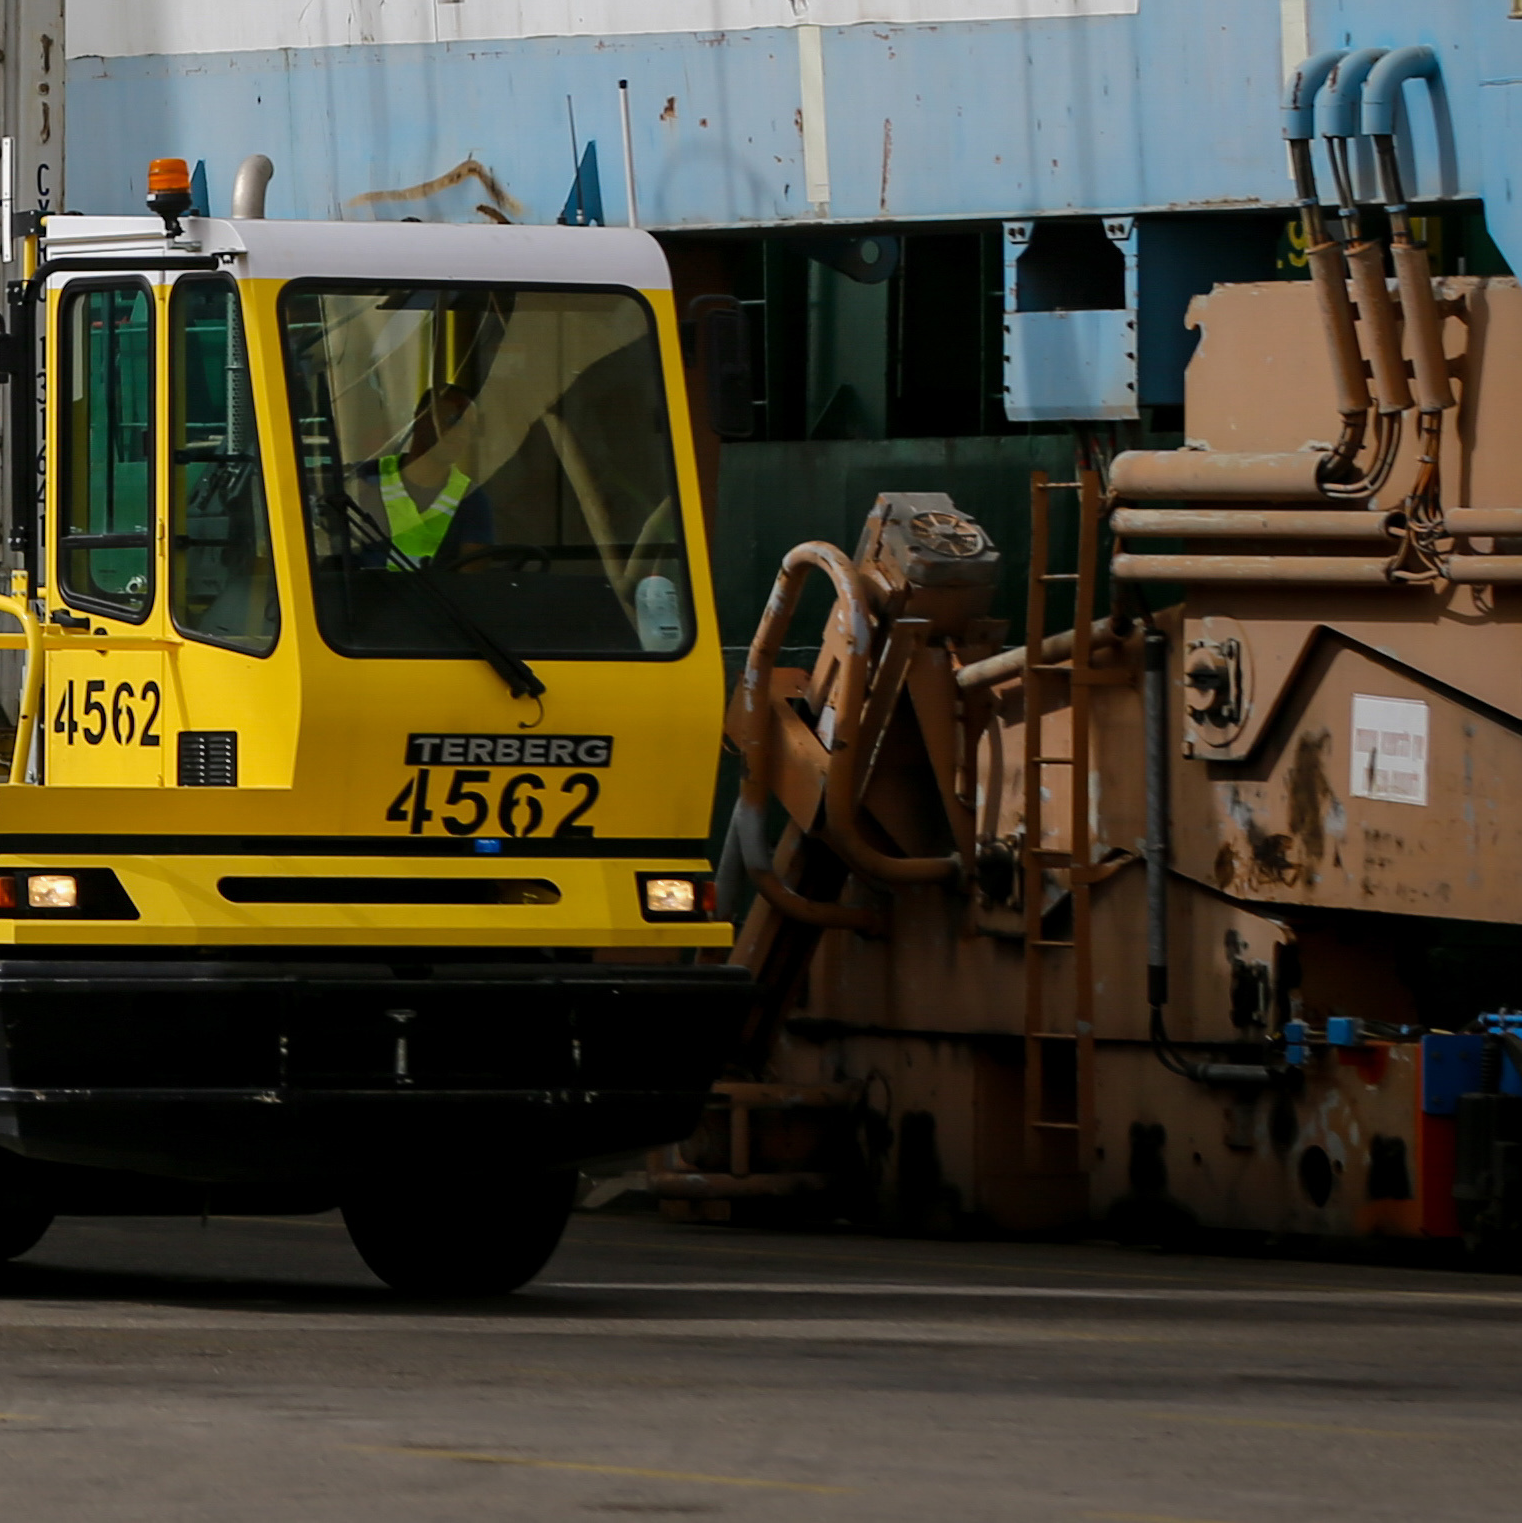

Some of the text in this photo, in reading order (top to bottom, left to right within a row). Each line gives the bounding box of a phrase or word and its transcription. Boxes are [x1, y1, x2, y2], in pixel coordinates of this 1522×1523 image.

[54, 679, 160, 747] 4562
[416, 736, 608, 764] TERBERG
[386, 768, 600, 838] 4562
